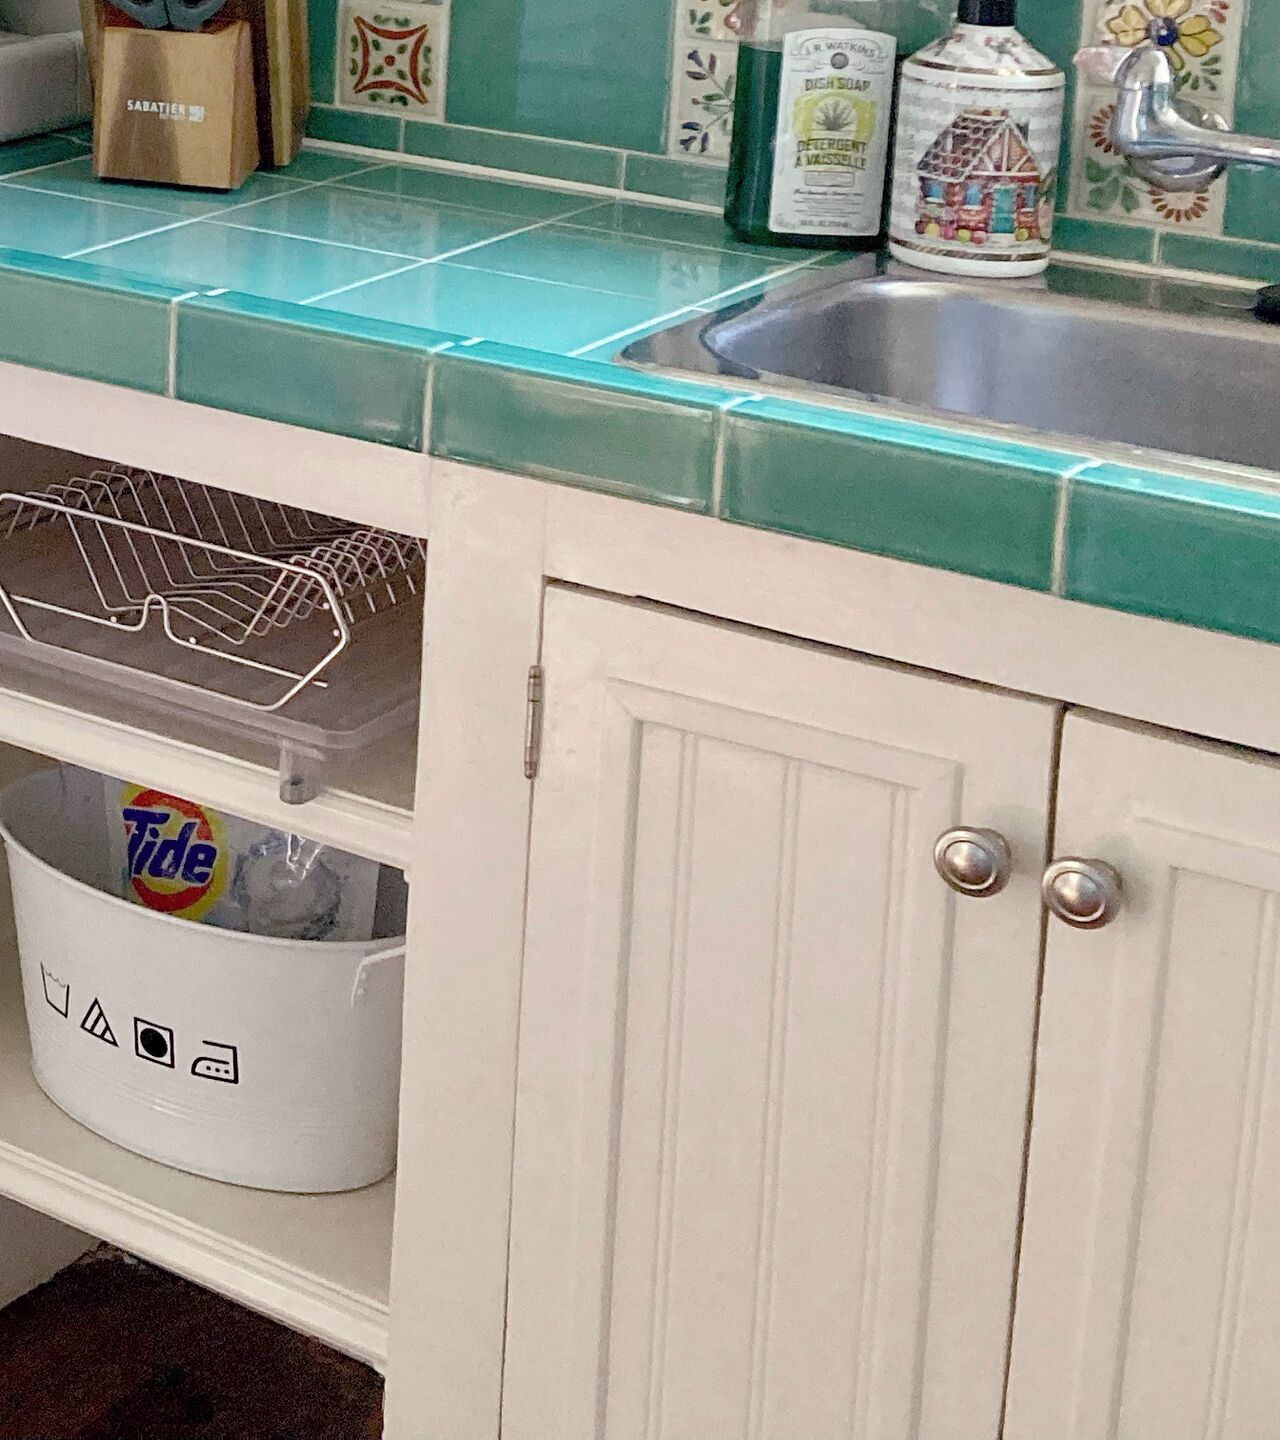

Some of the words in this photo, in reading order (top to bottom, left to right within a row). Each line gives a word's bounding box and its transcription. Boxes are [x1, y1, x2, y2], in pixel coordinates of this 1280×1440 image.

[805, 77, 835, 91] DISH
[836, 77, 871, 91] SOAP
[127, 99, 185, 115] SABATIER
[122, 807, 218, 884] Tide
